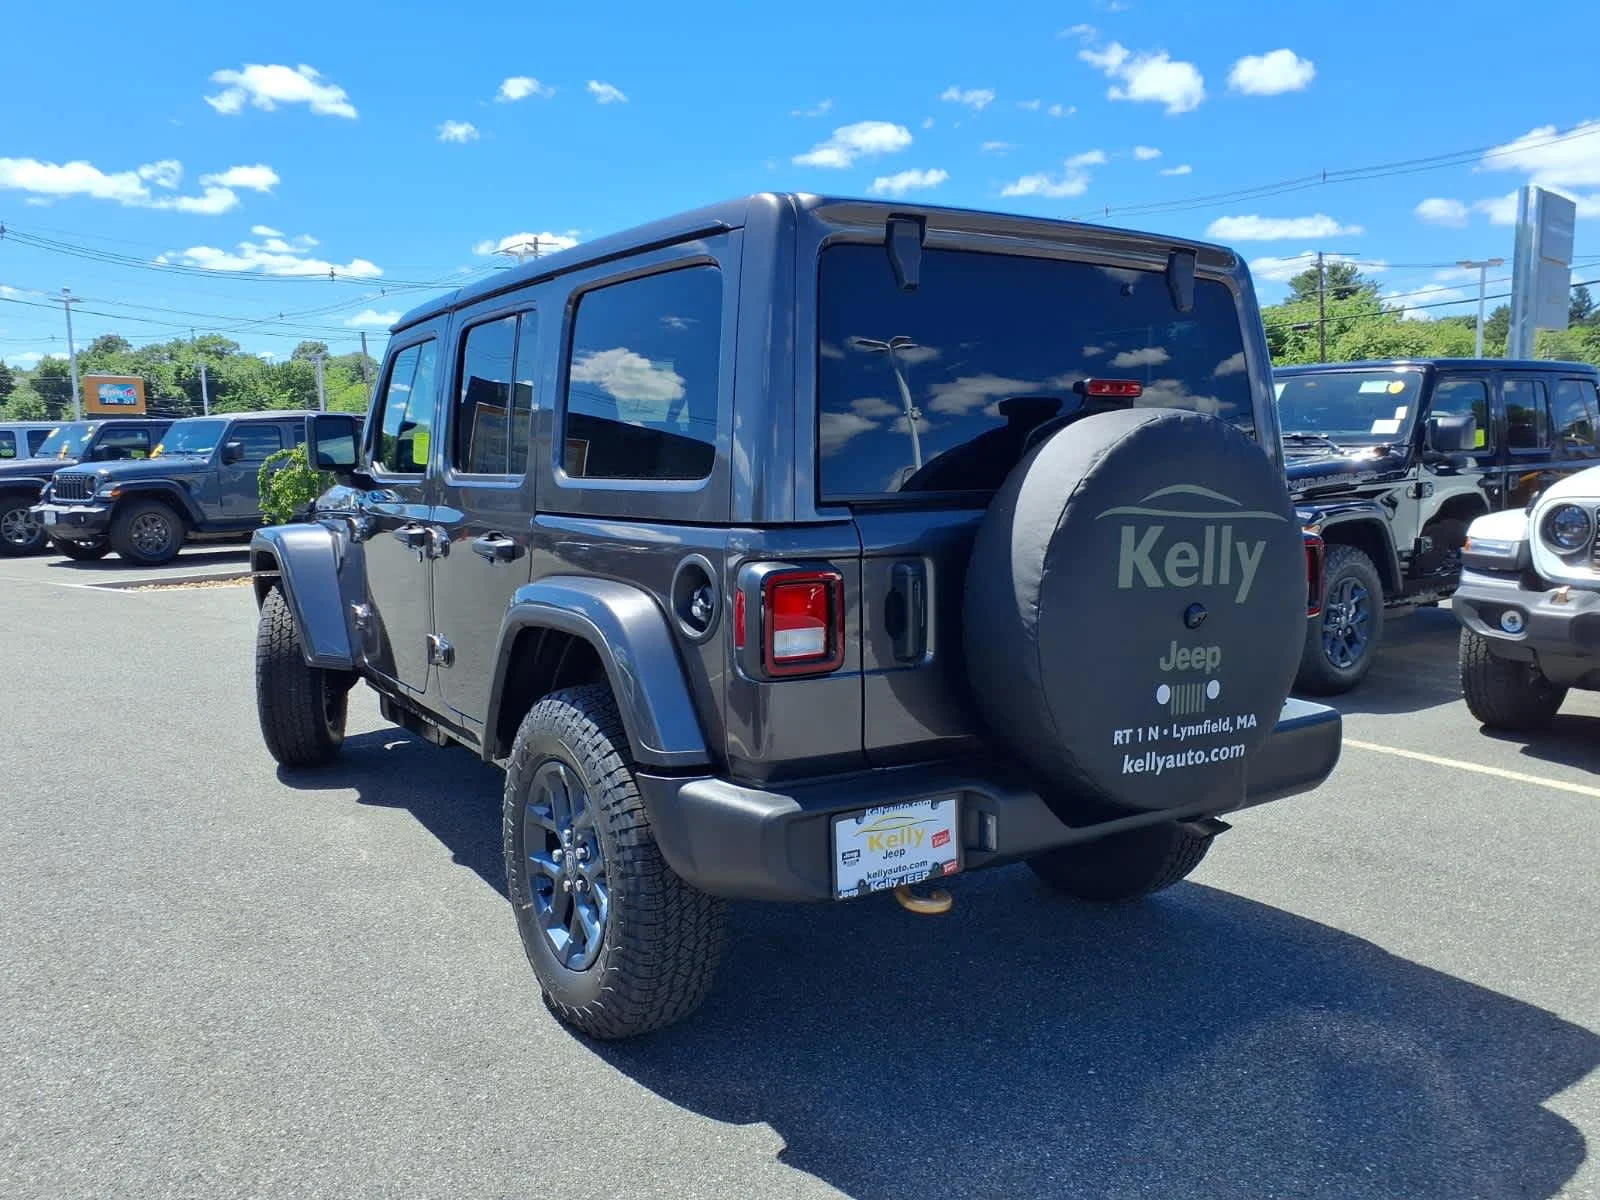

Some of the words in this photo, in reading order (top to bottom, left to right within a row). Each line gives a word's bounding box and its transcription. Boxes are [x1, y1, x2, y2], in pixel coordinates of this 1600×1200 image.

[1118, 525, 1267, 604] Kelly
[1160, 640, 1222, 675] Jeep
[1113, 729, 1133, 745] RT
[1137, 727, 1143, 743] 1
[1147, 725, 1159, 742] N
[1172, 716, 1234, 742] Lynnfield,
[1236, 713, 1257, 730] MA
[1122, 743, 1246, 776] kellyauto.com
[868, 827, 925, 852] Kelly
[882, 848, 906, 860] Jeep
[866, 859, 929, 880] kellyauto.com
[870, 878, 900, 892] Kelly
[900, 871, 930, 886] JEEP
